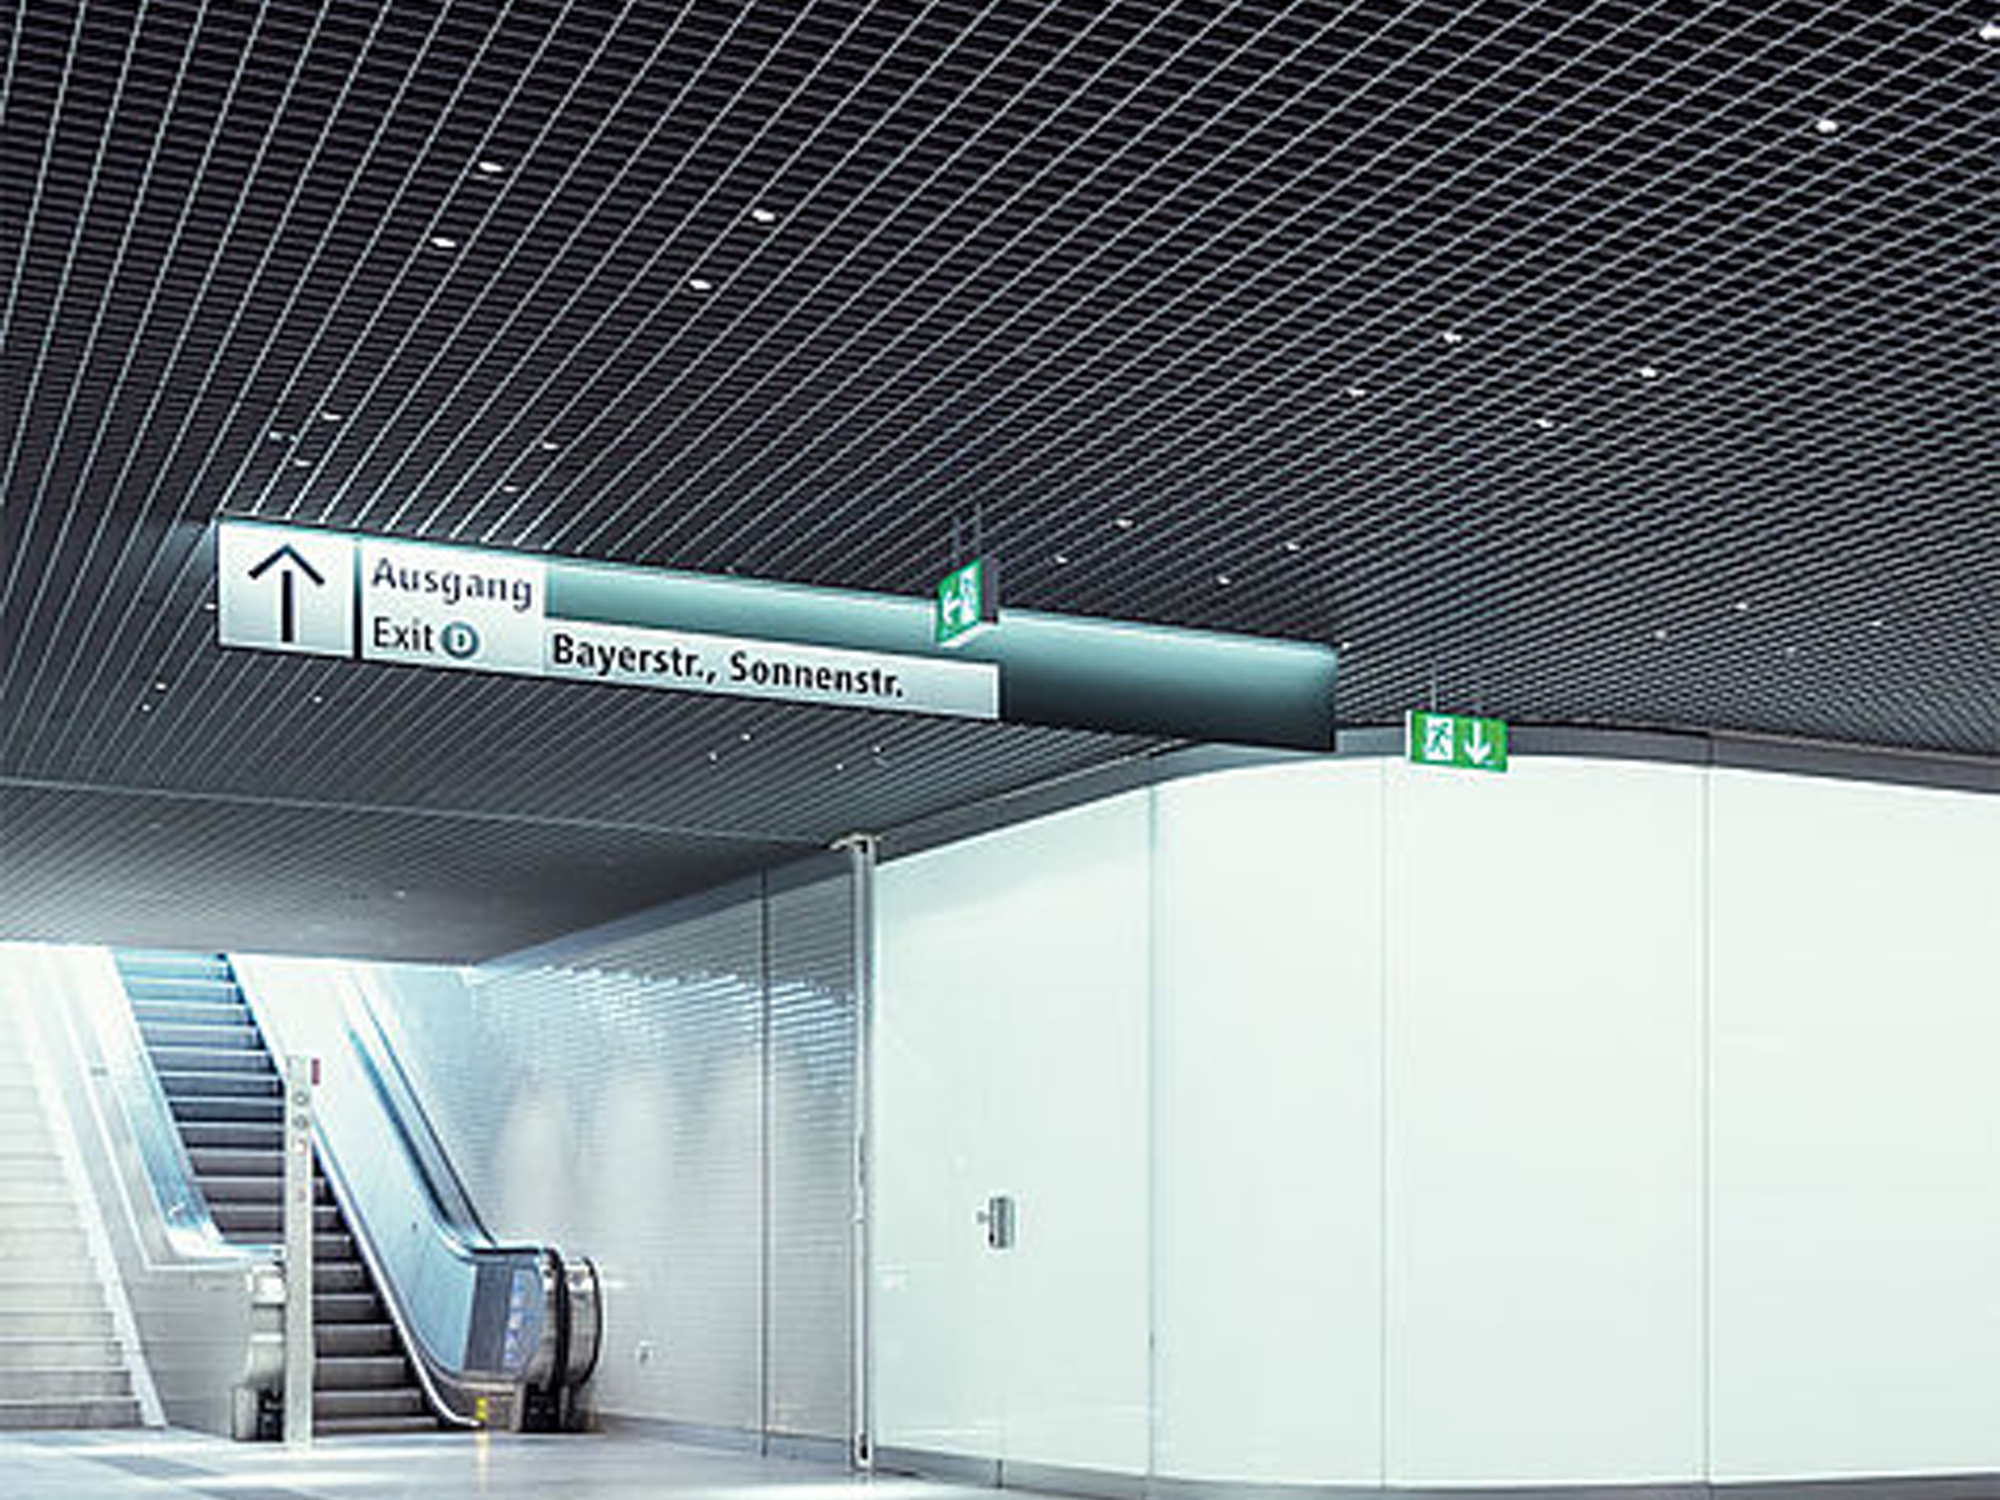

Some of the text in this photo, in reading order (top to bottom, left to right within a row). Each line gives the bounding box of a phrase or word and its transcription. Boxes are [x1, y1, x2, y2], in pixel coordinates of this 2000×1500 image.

[371, 556, 532, 612] Ausgang
[373, 616, 434, 652] Exit
[552, 633, 903, 698] Bayerstr., Sonnenstr.
